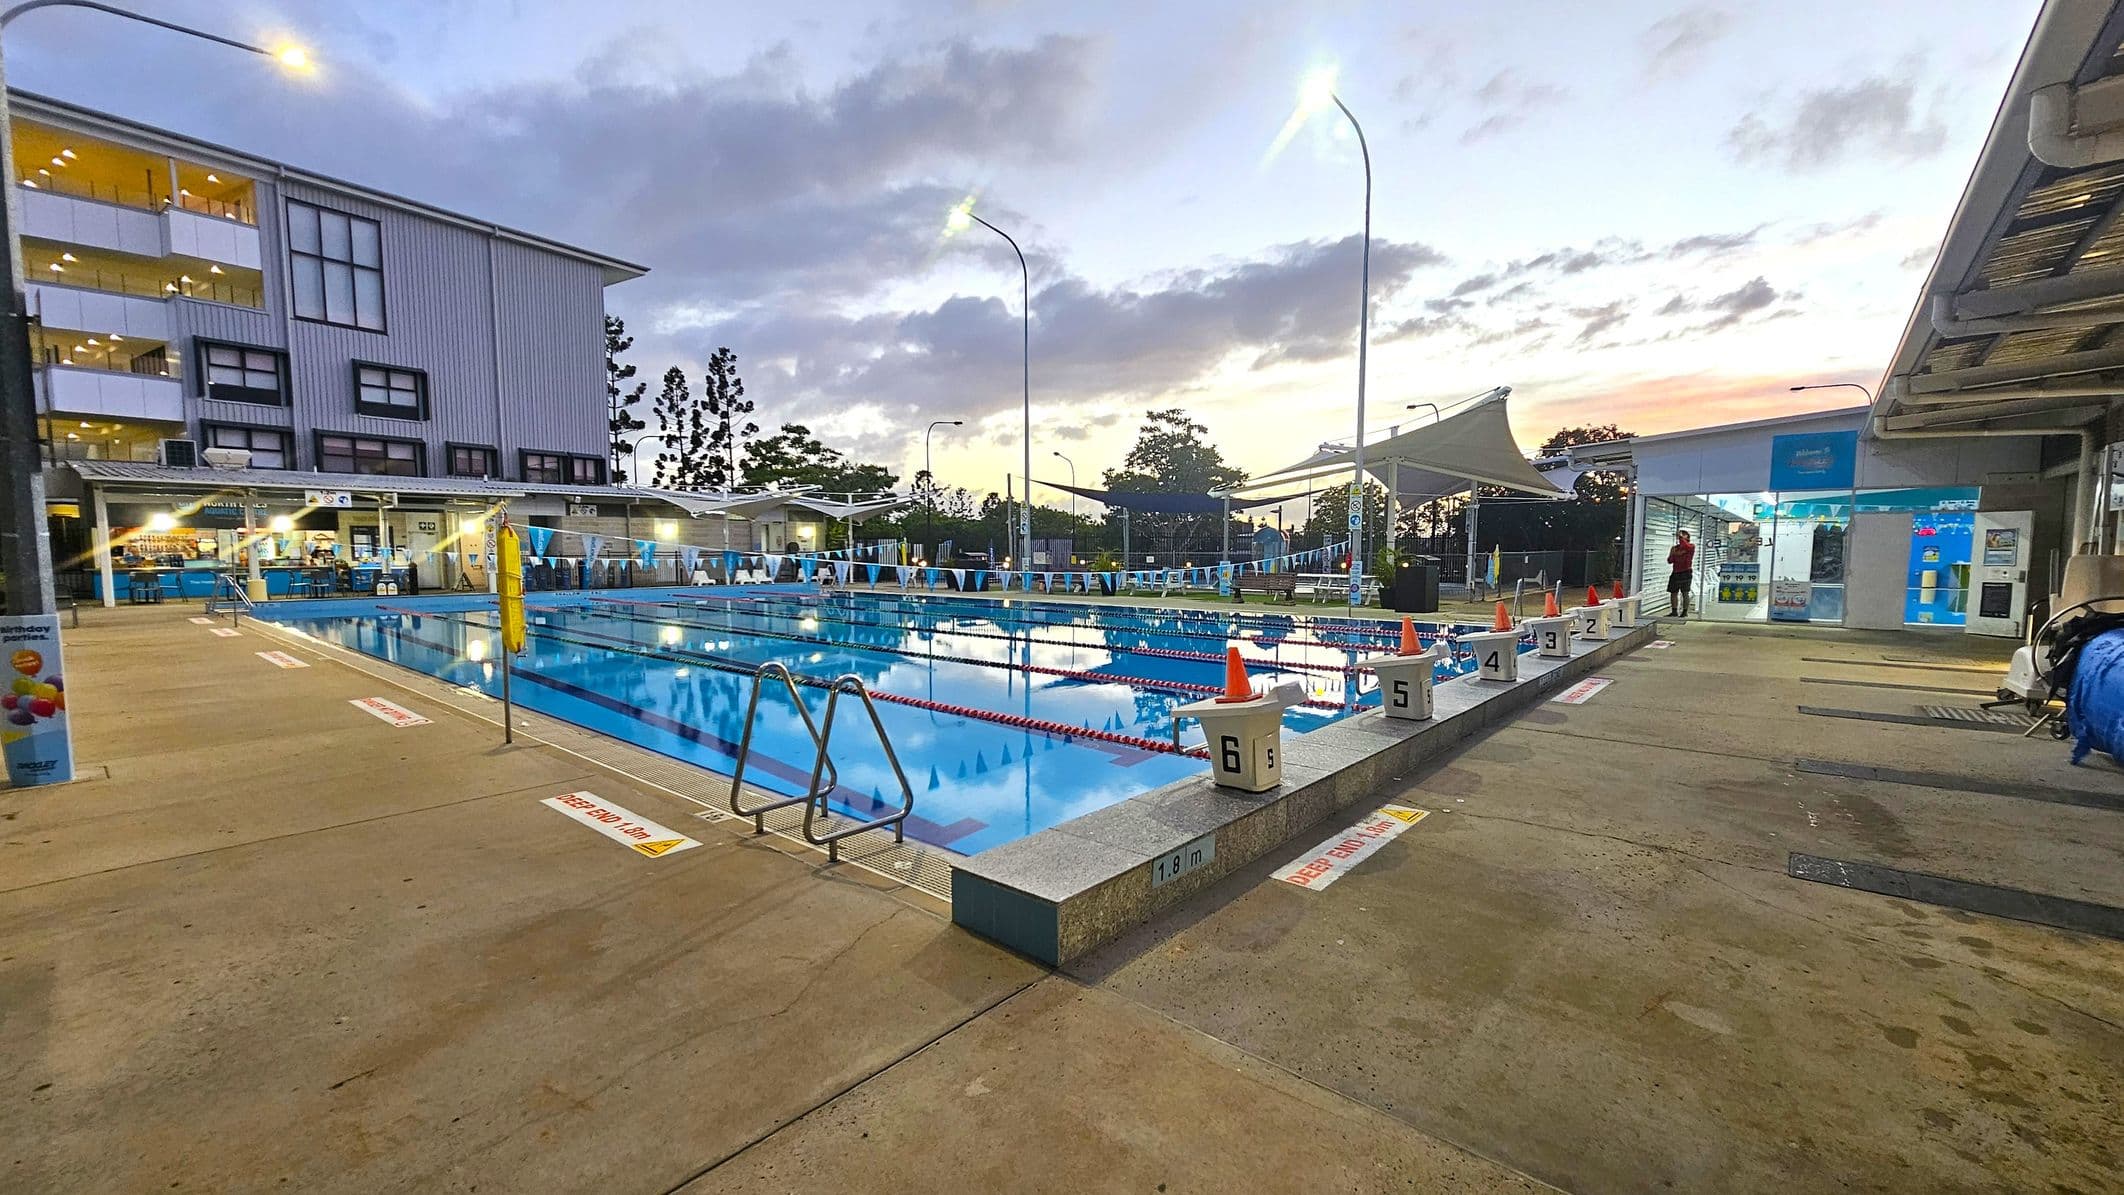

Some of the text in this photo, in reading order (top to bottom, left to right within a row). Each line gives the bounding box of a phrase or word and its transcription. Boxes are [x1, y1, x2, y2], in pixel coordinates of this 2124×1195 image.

[1586, 618, 1596, 634] 2
[1618, 609, 1623, 622] 1
[1545, 632, 1557, 650] 3
[1484, 651, 1500, 673] 4
[1393, 680, 1409, 709] 5
[1220, 735, 1242, 774] 6
[555, 793, 652, 841] DEEP END 1.8m
[1158, 849, 1202, 881] 1.8 m
[1287, 820, 1395, 886] DEEP END 1.8m
